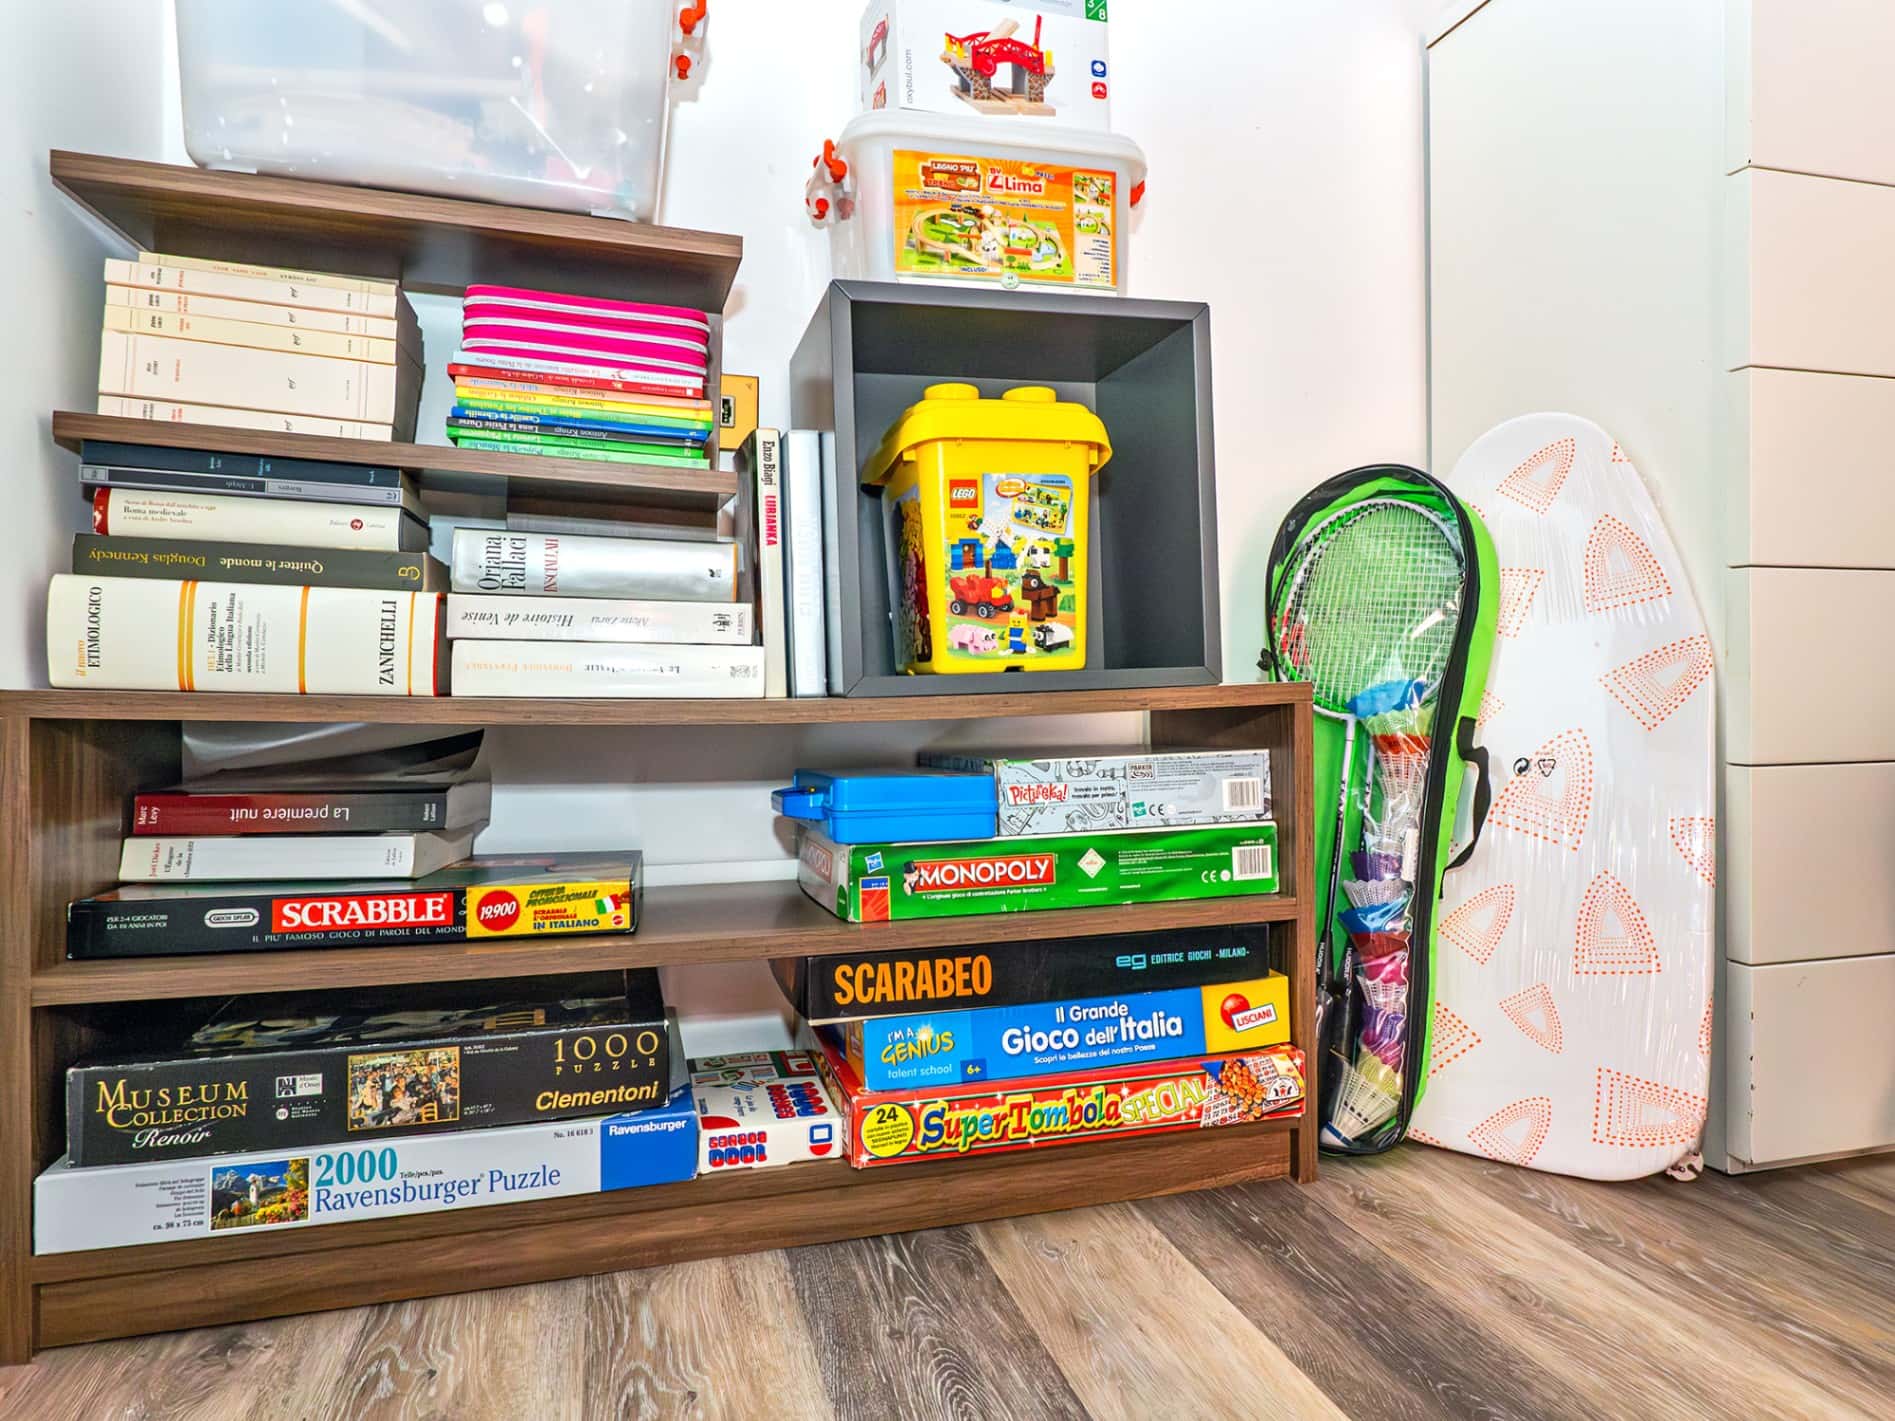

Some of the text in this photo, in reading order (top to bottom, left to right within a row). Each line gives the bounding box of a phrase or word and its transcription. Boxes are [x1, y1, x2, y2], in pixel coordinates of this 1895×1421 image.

[1005, 176, 1042, 193] Lima
[485, 421, 507, 430] Petite
[518, 425, 538, 433] Luna
[761, 441, 776, 485] Enzo Biagi
[953, 488, 975, 498] LEGO
[124, 506, 146, 514] Roma
[88, 548, 323, 574] Quitter le monde Douglas Kennedy
[477, 536, 502, 590] Oriana
[501, 537, 527, 591] Fallaci
[544, 538, 559, 592] INSCIALLAH
[87, 587, 102, 667] ETIMOLOGICO
[208, 602, 217, 642] Dizionario
[461, 611, 574, 628] Histoire de Venise
[225, 593, 235, 672] della Lingua Italiana
[379, 600, 397, 686] ZANICHELLI
[77, 640, 85, 667] nuovo
[216, 626, 225, 672] Etimologico
[1009, 784, 1068, 805] Pictureka!
[138, 806, 148, 825] Marc
[149, 806, 160, 824] Levy
[230, 804, 350, 822] La première nuit
[920, 859, 1049, 886] MONOPOLY
[526, 890, 598, 907] PROMOZIONALE
[529, 886, 565, 898] OFFERTA
[282, 898, 445, 927] SCRABBLE
[480, 901, 516, 920] 19.900
[534, 913, 577, 921] L'ORIGINALE
[534, 919, 599, 929] IN ITALIANO
[252, 935, 259, 943] IL
[286, 933, 324, 941] FAMOSO
[329, 931, 361, 939] GIOCO
[380, 928, 410, 936] PAROLE
[1116, 954, 1146, 969] eg
[1151, 952, 1184, 964] EDITRICE
[1188, 950, 1211, 961] GIOCHI
[834, 955, 992, 1004] SCARABEO
[1056, 1001, 1128, 1023] Il Grande
[1236, 1010, 1272, 1026] LISCIANI
[888, 1027, 913, 1043] I'M A
[1002, 1025, 1079, 1055] Gioco
[554, 1031, 659, 1062] 1000
[881, 1032, 954, 1066] GENIUS
[1035, 1056, 1057, 1064] Scopri
[1068, 1051, 1098, 1060] bellezze
[1112, 1047, 1133, 1055] nostro
[1135, 1044, 1156, 1052] Paese
[556, 1057, 656, 1076] PUZZLE
[888, 1064, 952, 1079] talent school
[967, 1065, 982, 1075] 6+
[96, 1079, 248, 1113] MUSEUM
[536, 1081, 659, 1112] Clementoni
[1121, 1076, 1208, 1124] SPECIAL
[107, 1103, 247, 1128] COLLECTION
[877, 1107, 898, 1124] 24
[609, 1119, 687, 1136] Ravensburger
[132, 1128, 212, 1149] Renoir
[708, 1131, 767, 1149] BORNES
[708, 1144, 767, 1168] 1000
[315, 1147, 398, 1188] 2000
[315, 1165, 561, 1213] Ravensburger Puzzle
